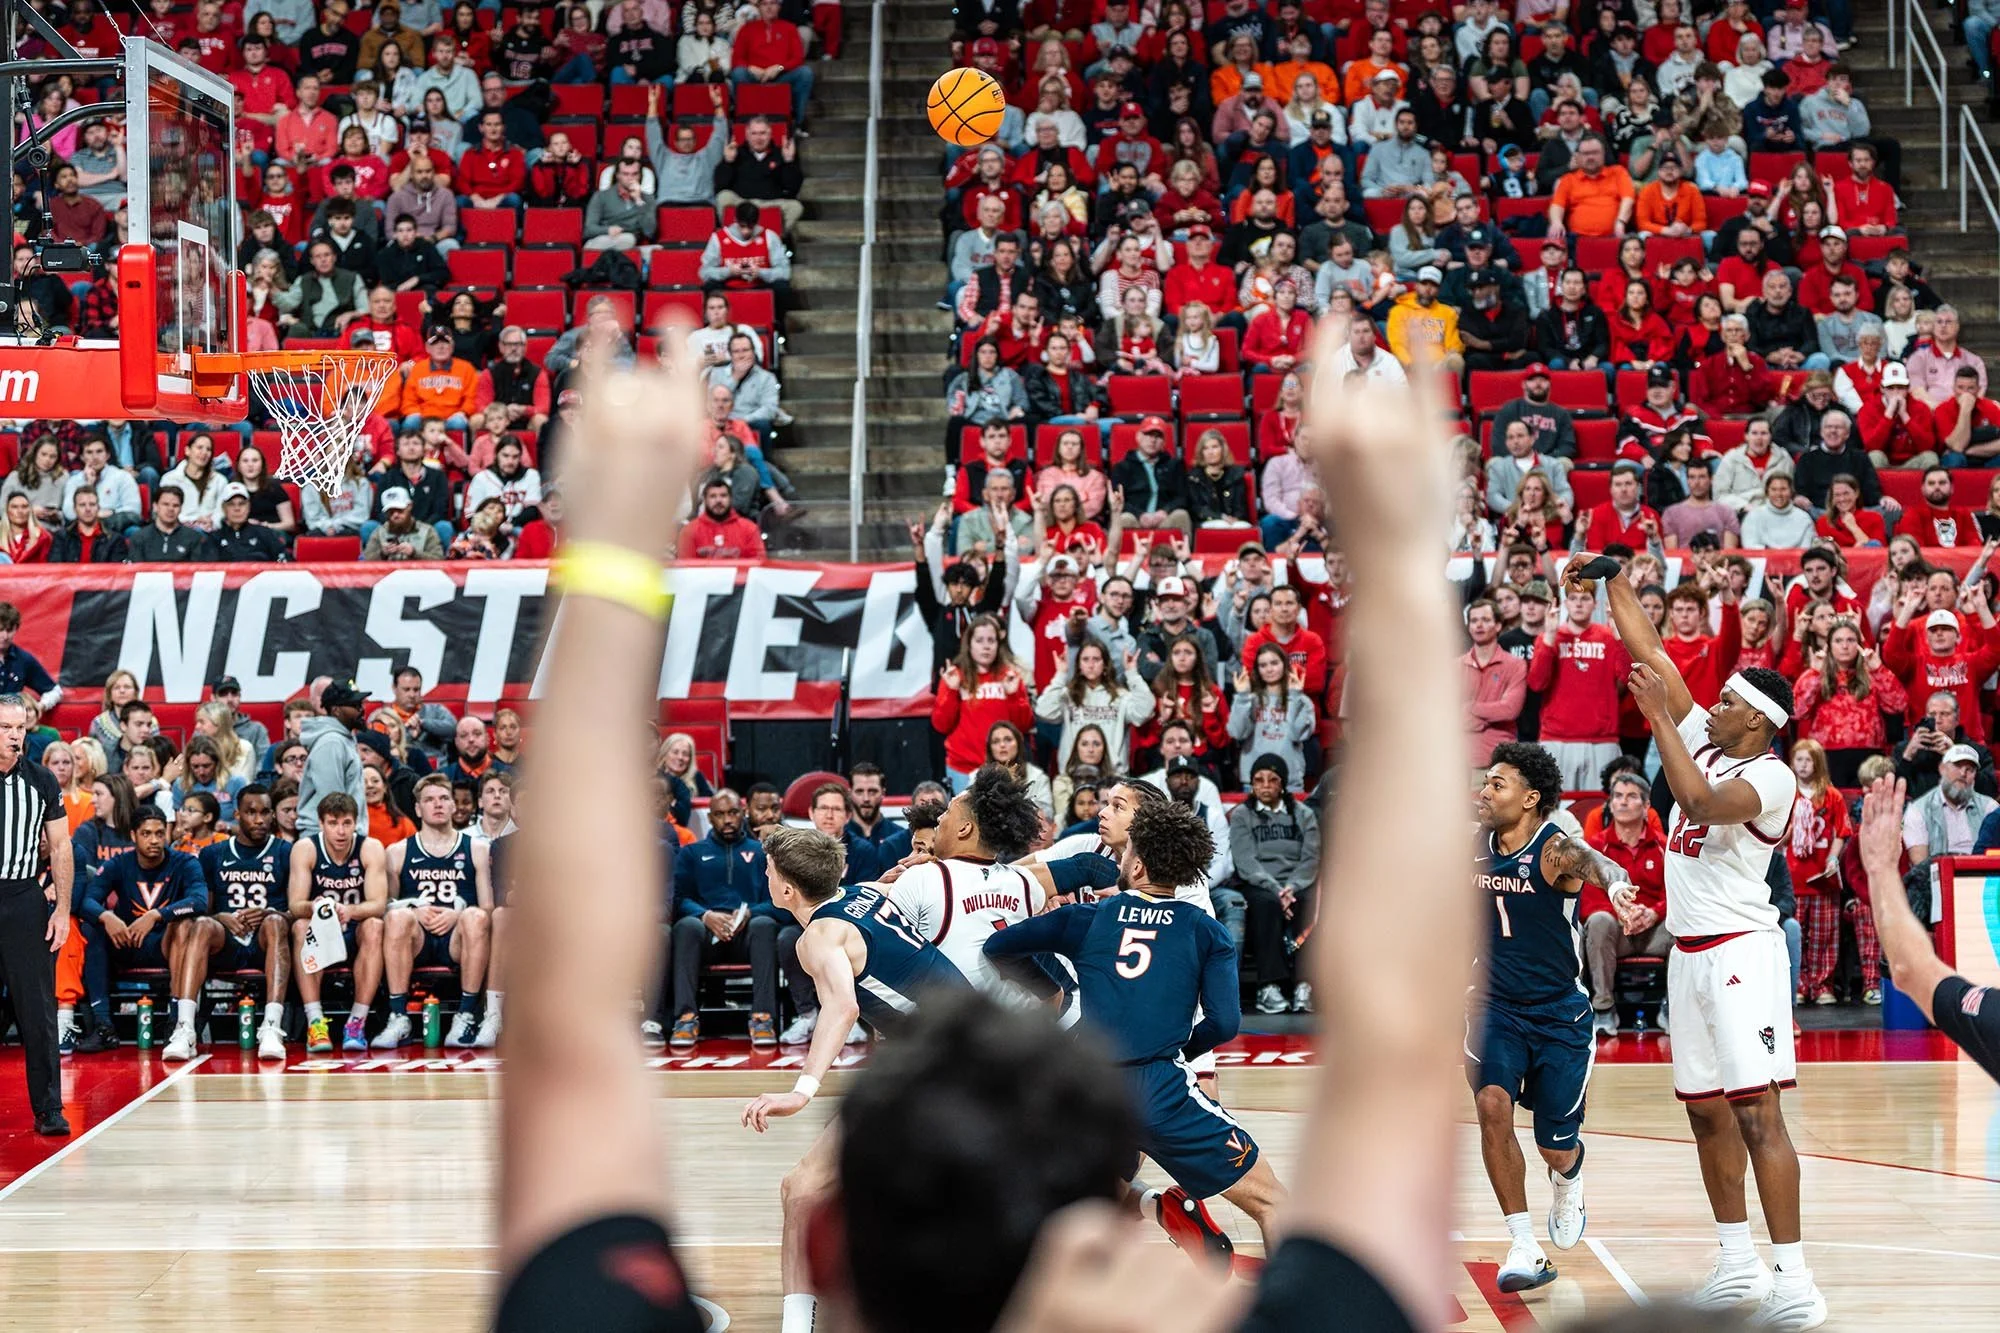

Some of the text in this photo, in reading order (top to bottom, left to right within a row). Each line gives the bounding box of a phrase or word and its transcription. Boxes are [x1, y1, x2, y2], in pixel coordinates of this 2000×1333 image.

[1503, 176, 1524, 199] 9
[114, 571, 322, 703] NC
[355, 569, 814, 703] STTE
[1573, 640, 1606, 660] STATE
[219, 869, 276, 884] VIRGINIA
[315, 874, 365, 890] VIRGINIA
[409, 868, 466, 882] VIRGINIA
[226, 883, 268, 910] 33
[417, 880, 457, 903] 28
[962, 893, 1020, 915] WILLIAMS
[1117, 905, 1175, 926] LEWIS
[1495, 896, 1513, 938] 1
[1115, 927, 1158, 980] 5
